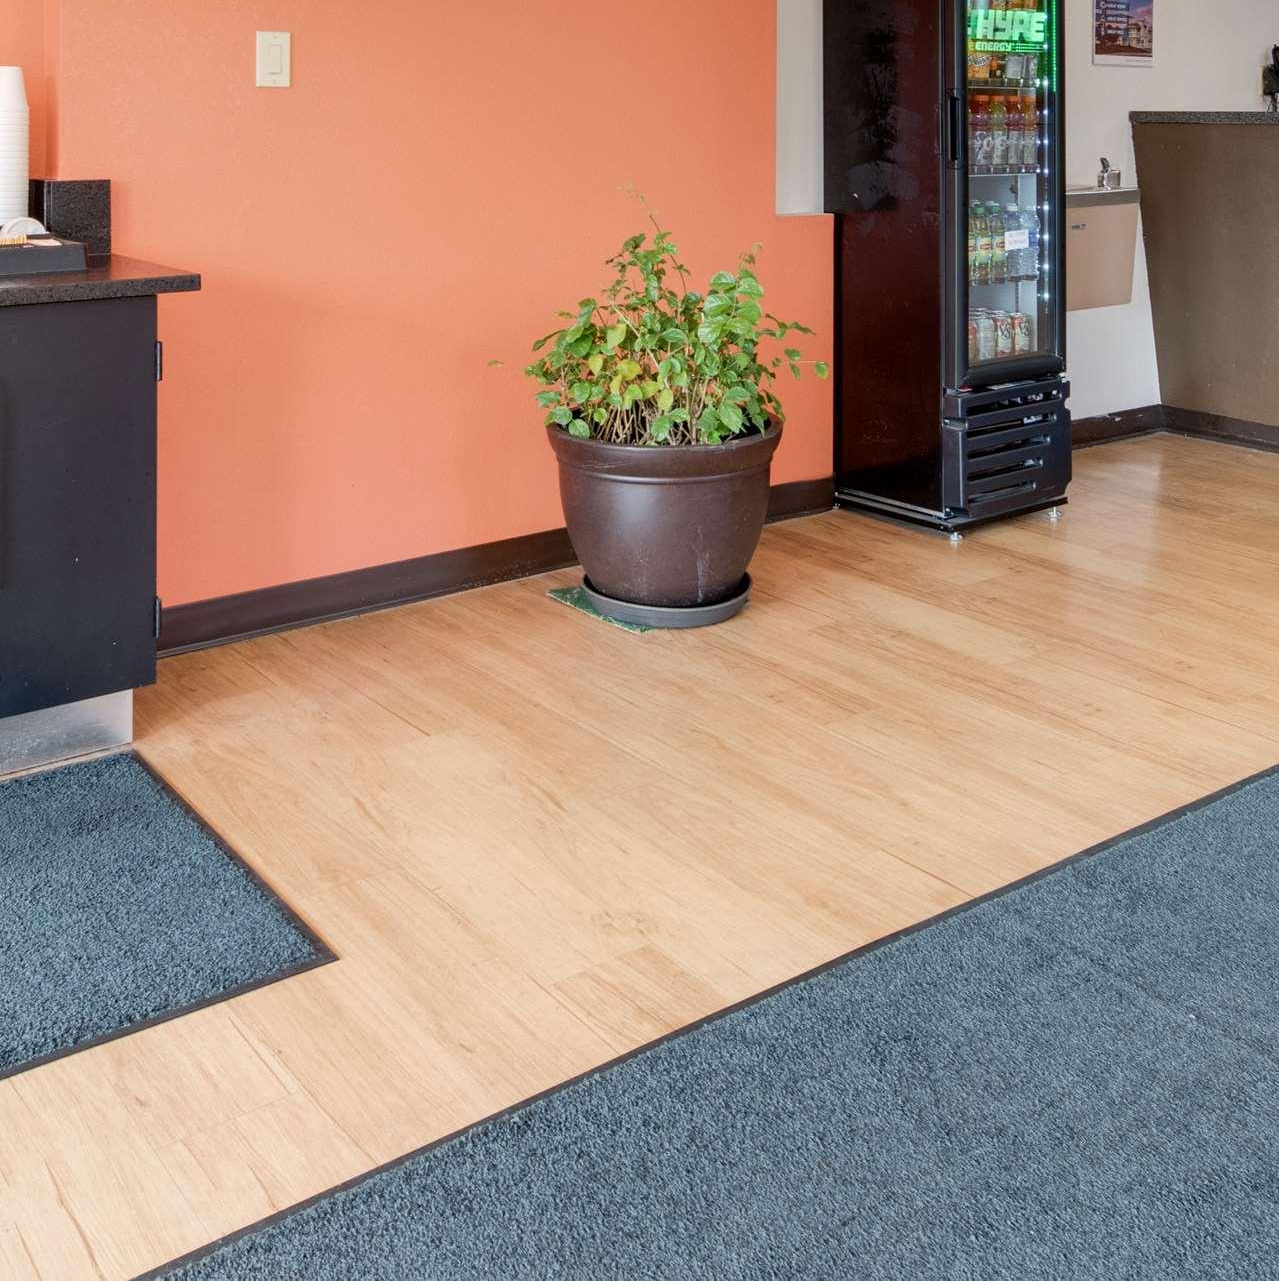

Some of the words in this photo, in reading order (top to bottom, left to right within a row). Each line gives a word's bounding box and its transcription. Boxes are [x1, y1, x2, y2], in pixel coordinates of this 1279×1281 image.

[976, 8, 1046, 42] HYPE
[975, 41, 1012, 52] ENERGY
[999, 323, 1011, 339] V8
